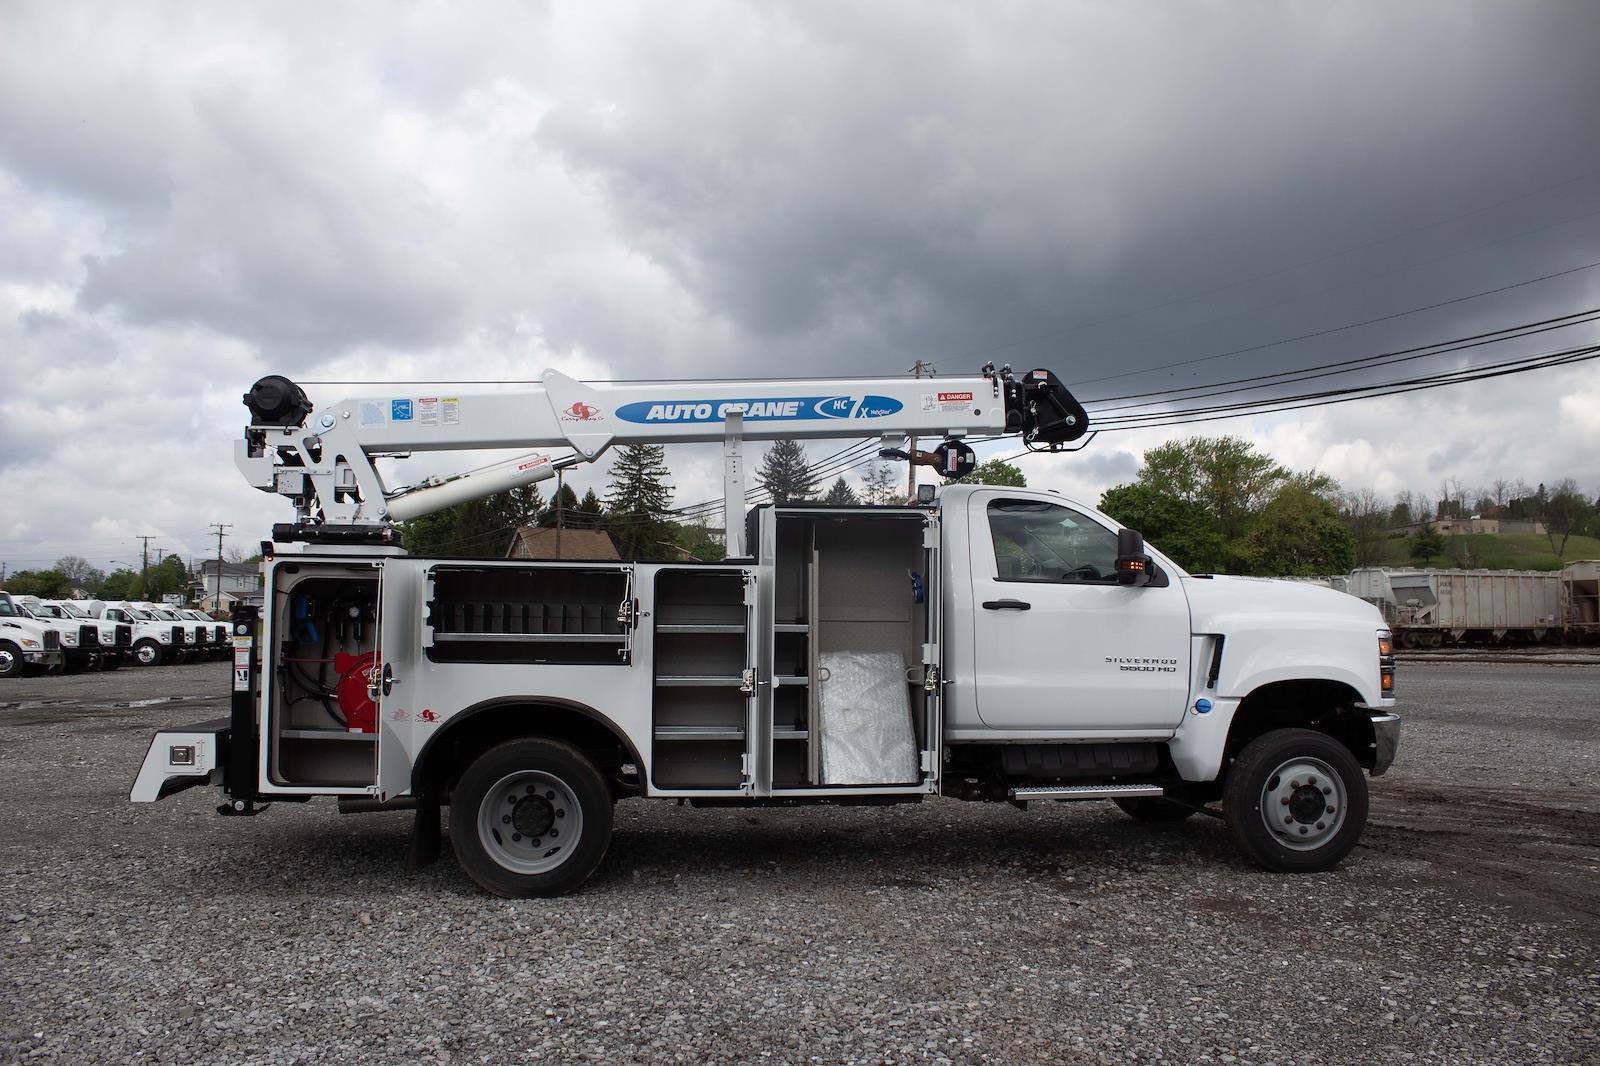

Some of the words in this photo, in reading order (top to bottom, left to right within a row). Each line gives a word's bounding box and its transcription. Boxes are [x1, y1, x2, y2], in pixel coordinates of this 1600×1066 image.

[833, 400, 848, 410] HC
[645, 403, 712, 420] AUTO
[1105, 657, 1177, 665] SILVERADO
